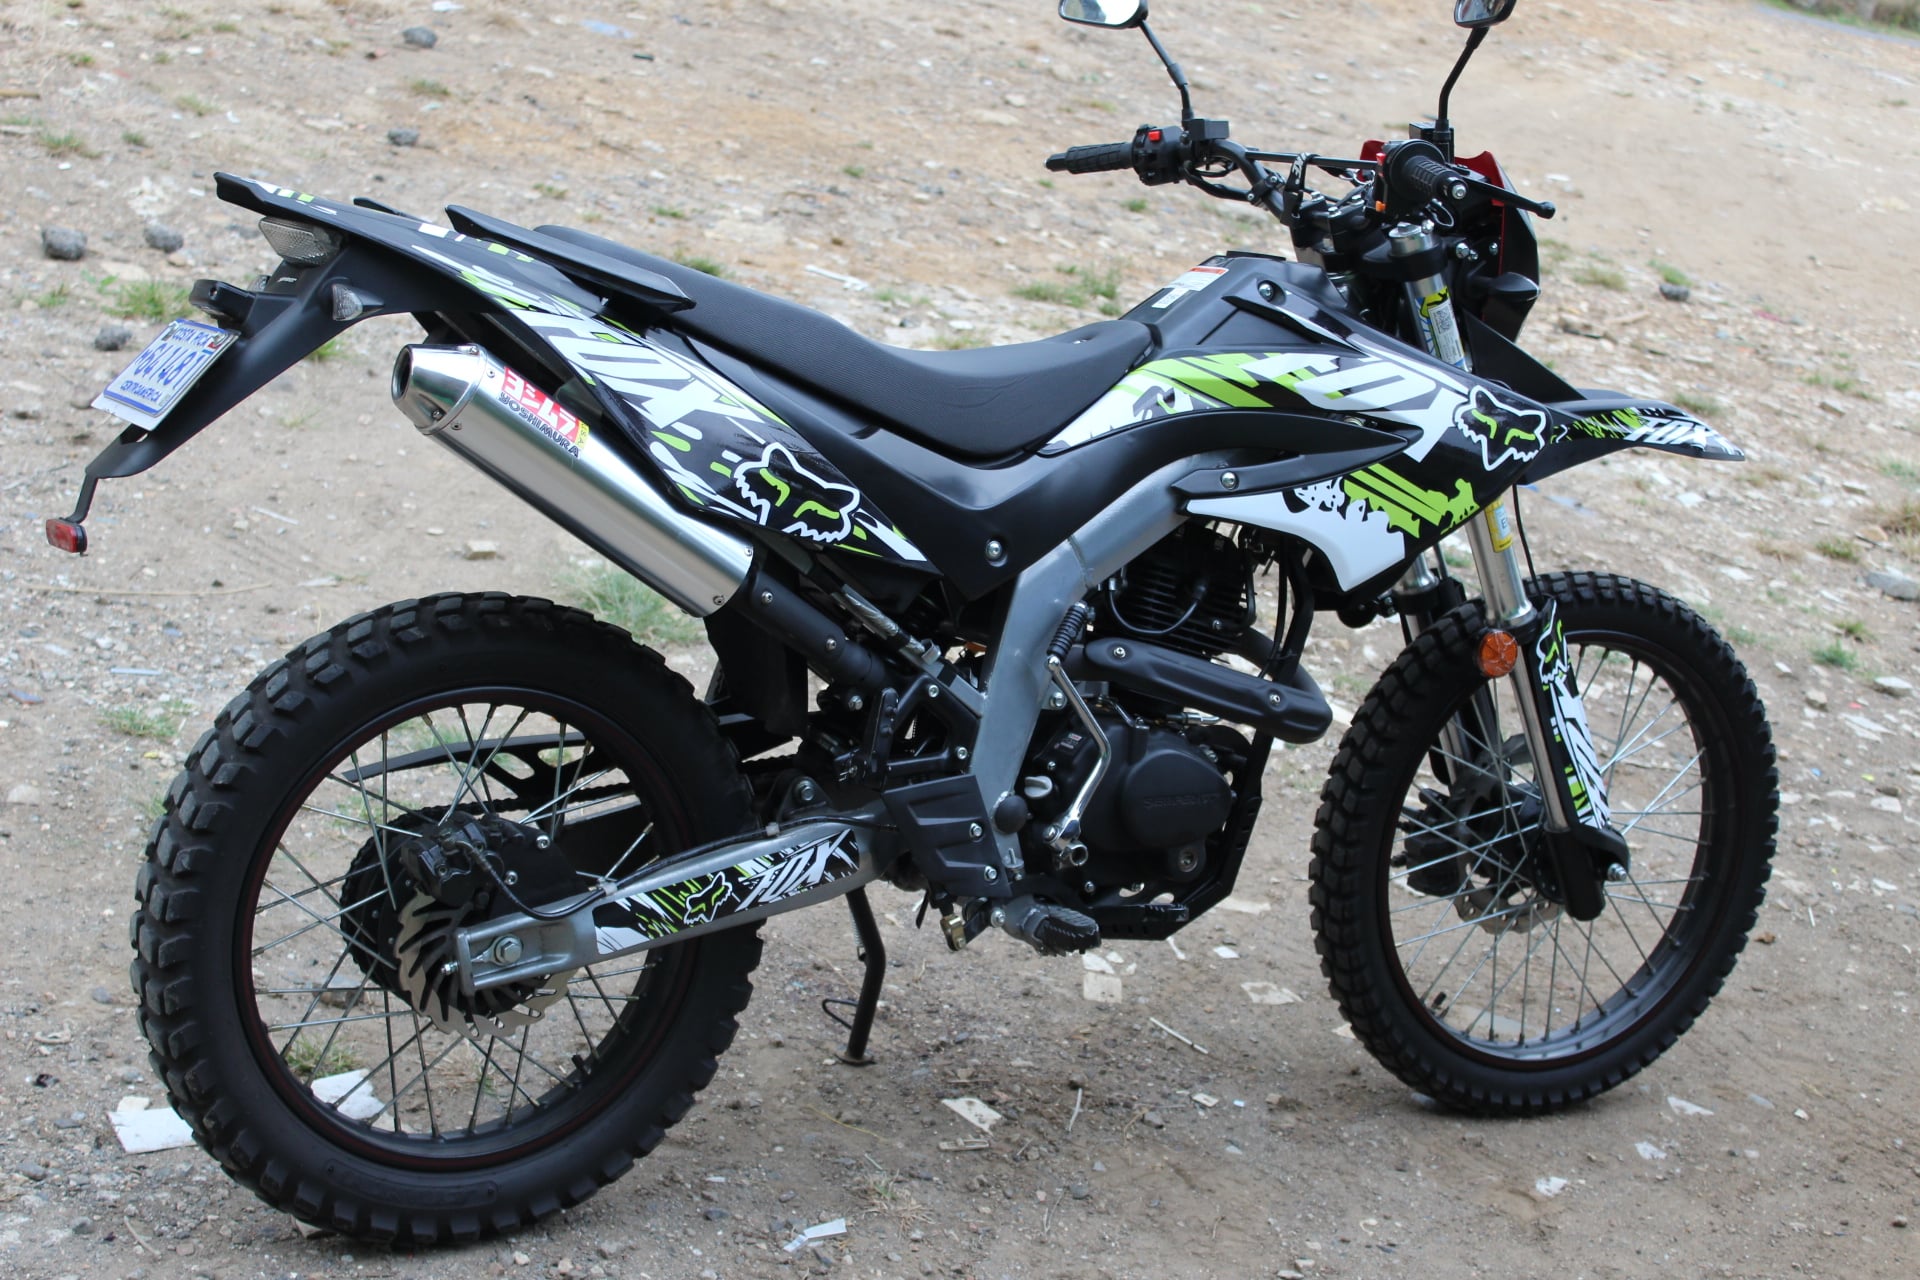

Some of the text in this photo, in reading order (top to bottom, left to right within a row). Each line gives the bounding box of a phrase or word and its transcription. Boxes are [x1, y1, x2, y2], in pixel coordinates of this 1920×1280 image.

[172, 327, 212, 347] COSTA RICA
[497, 392, 581, 459] YOSHIMURA
[503, 370, 577, 437] ヨシムラ
